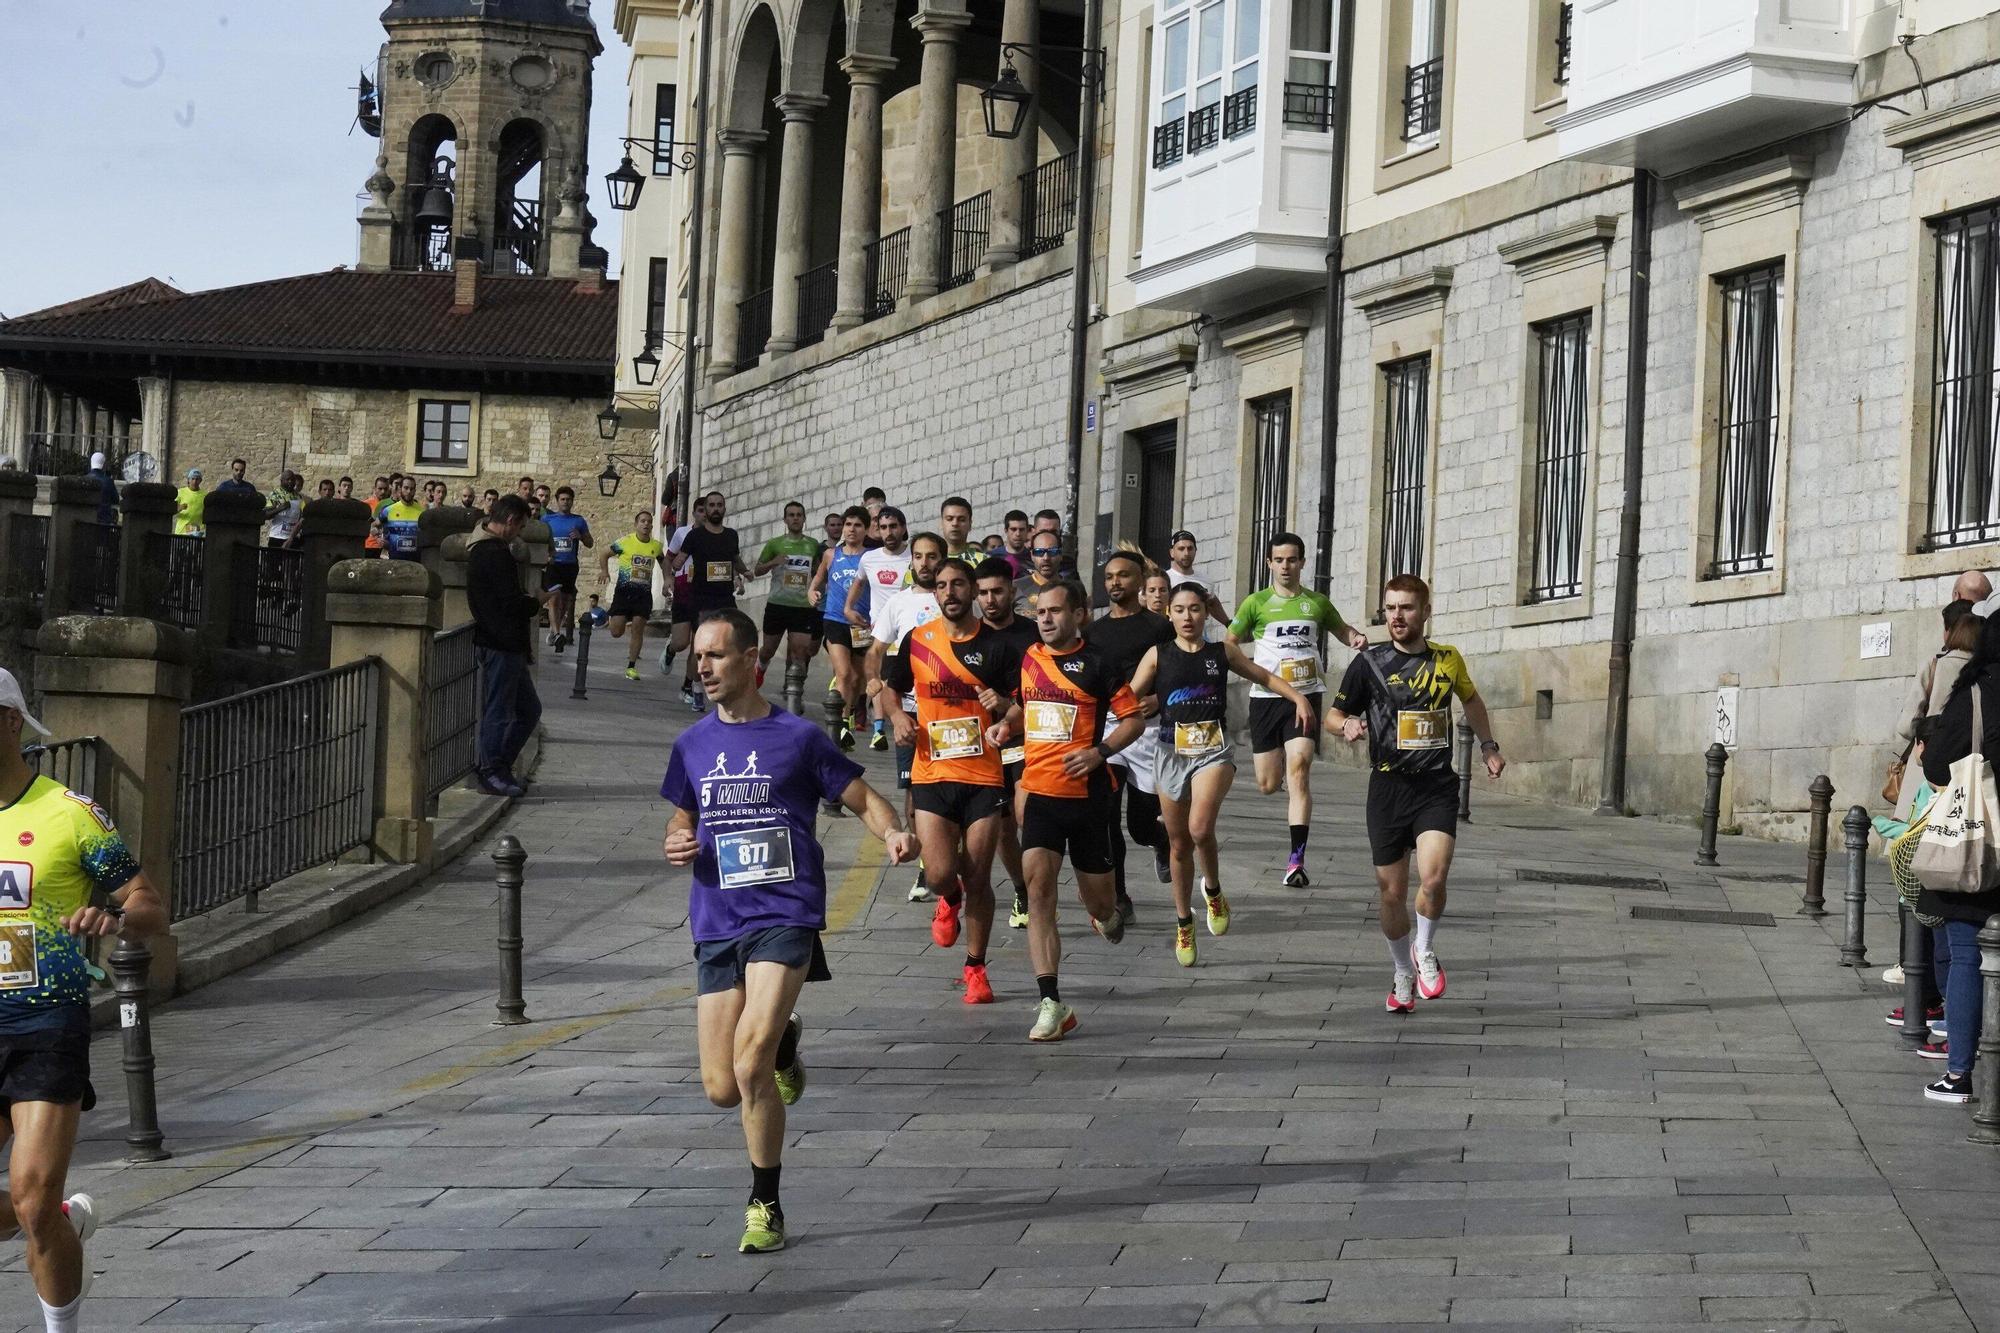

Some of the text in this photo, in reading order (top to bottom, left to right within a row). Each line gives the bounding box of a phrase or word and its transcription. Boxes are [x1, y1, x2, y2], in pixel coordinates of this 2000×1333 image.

[832, 572, 842, 582] EL
[1276, 625, 1310, 637] LEA
[942, 728, 968, 743] 403
[1187, 730, 1209, 745] 232
[701, 782, 770, 807] 5 MILIA
[759, 807, 788, 816] KROSA
[738, 842, 769, 866] 877
